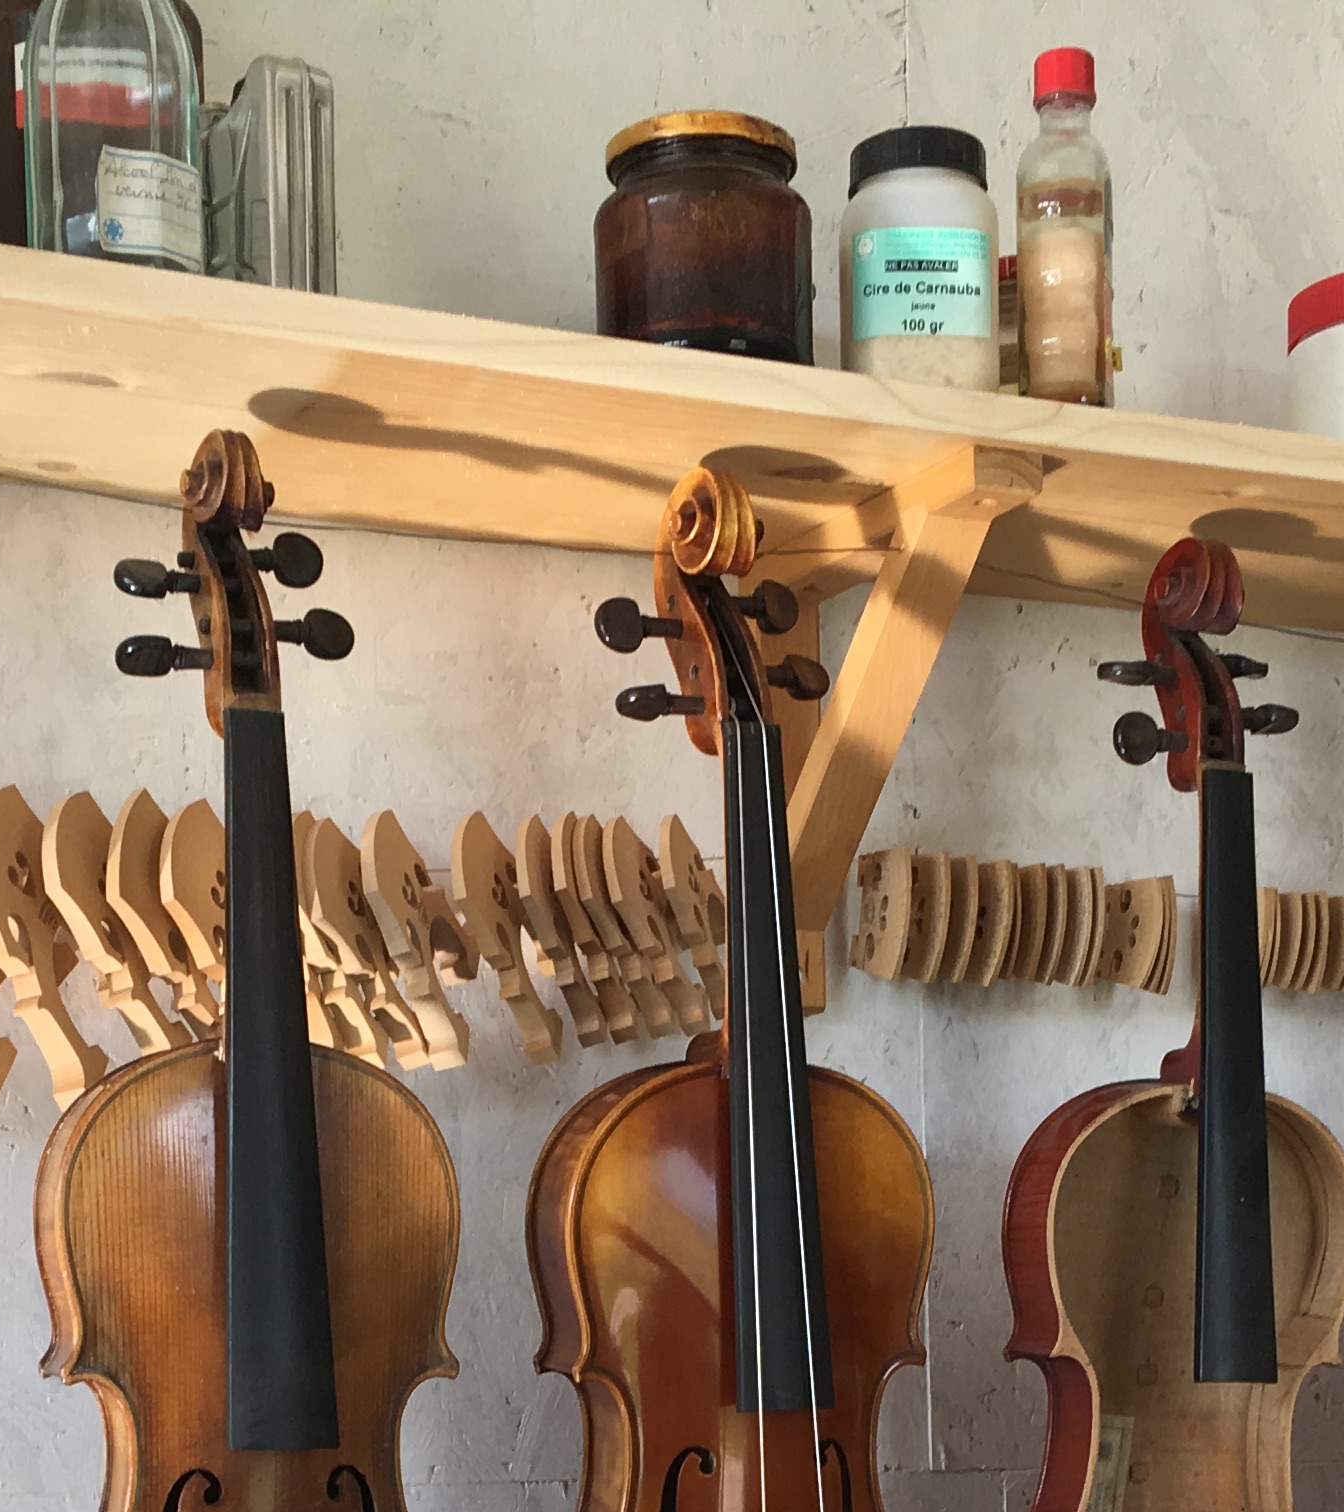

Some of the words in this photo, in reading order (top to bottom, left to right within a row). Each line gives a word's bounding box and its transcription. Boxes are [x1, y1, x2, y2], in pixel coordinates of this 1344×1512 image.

[900, 260, 919, 271] PAS
[921, 260, 958, 272] AVALER
[863, 283, 890, 298] Cire
[894, 281, 912, 295] de
[916, 281, 981, 297] Carnauba
[911, 301, 936, 312] jaune
[901, 319, 926, 332] 100
[929, 320, 945, 335] gr
